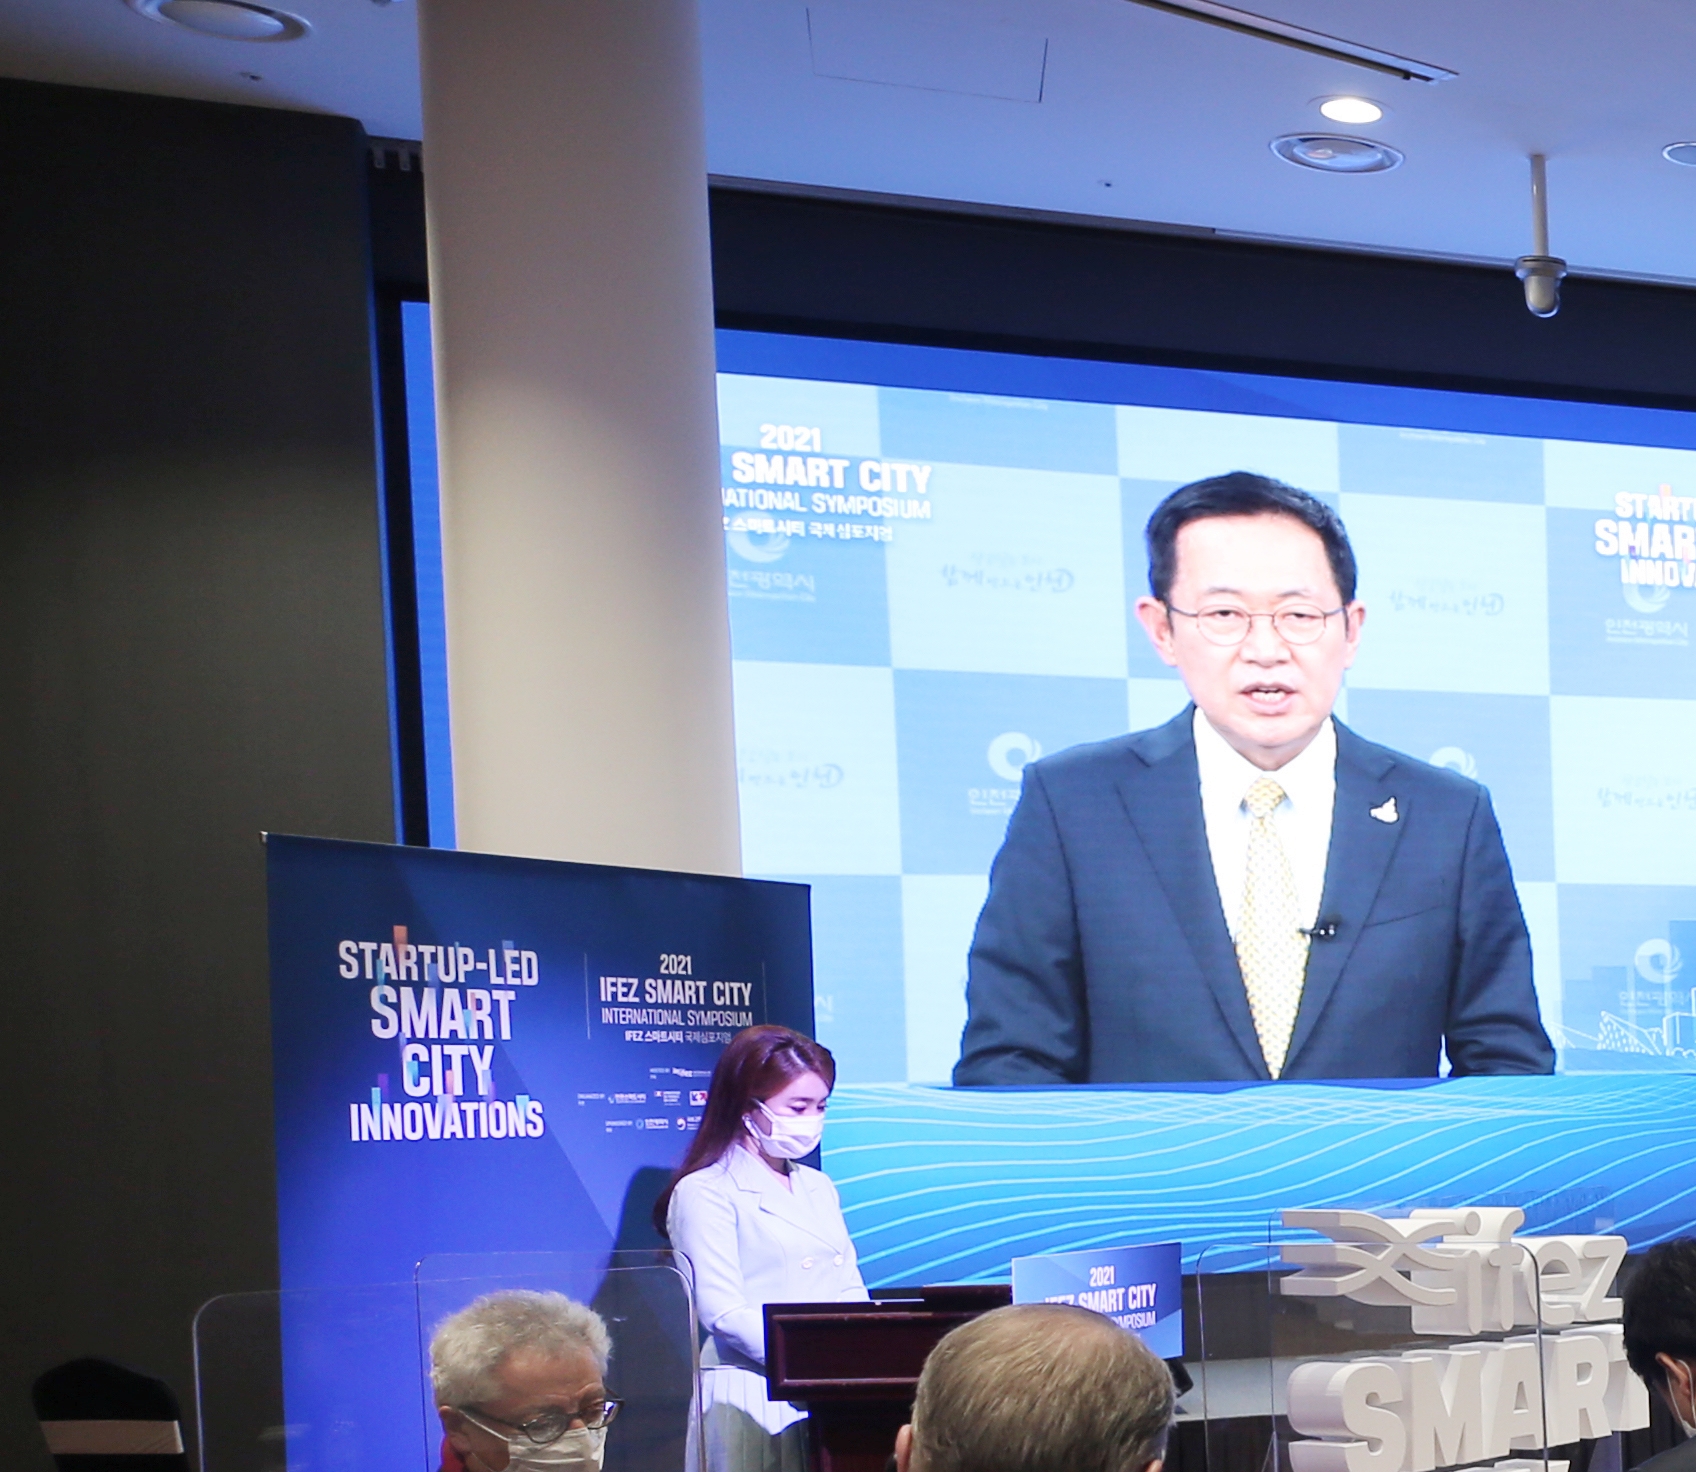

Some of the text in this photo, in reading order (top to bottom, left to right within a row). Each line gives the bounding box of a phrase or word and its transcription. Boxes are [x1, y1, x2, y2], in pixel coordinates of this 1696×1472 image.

[760, 423, 821, 452] 2021
[731, 451, 932, 494] SMART CITY
[722, 488, 931, 519] ATIONAL SYMPOSIUM
[729, 569, 816, 592] 천광역시
[339, 940, 539, 986] STARTUP-LED
[660, 953, 692, 975] 2021
[600, 976, 752, 1006] IFEZ SMART CITY
[370, 985, 516, 1041] SMART
[602, 1007, 752, 1026] INTERNATIONAL SYMPOSIUM
[625, 1030, 643, 1041] IFEZ
[402, 1043, 494, 1097] CITY
[350, 1100, 545, 1142] INNOVATIONS
[1089, 1265, 1115, 1287] 2021
[1078, 1287, 1125, 1313] SMART
[1128, 1283, 1157, 1310] CITY
